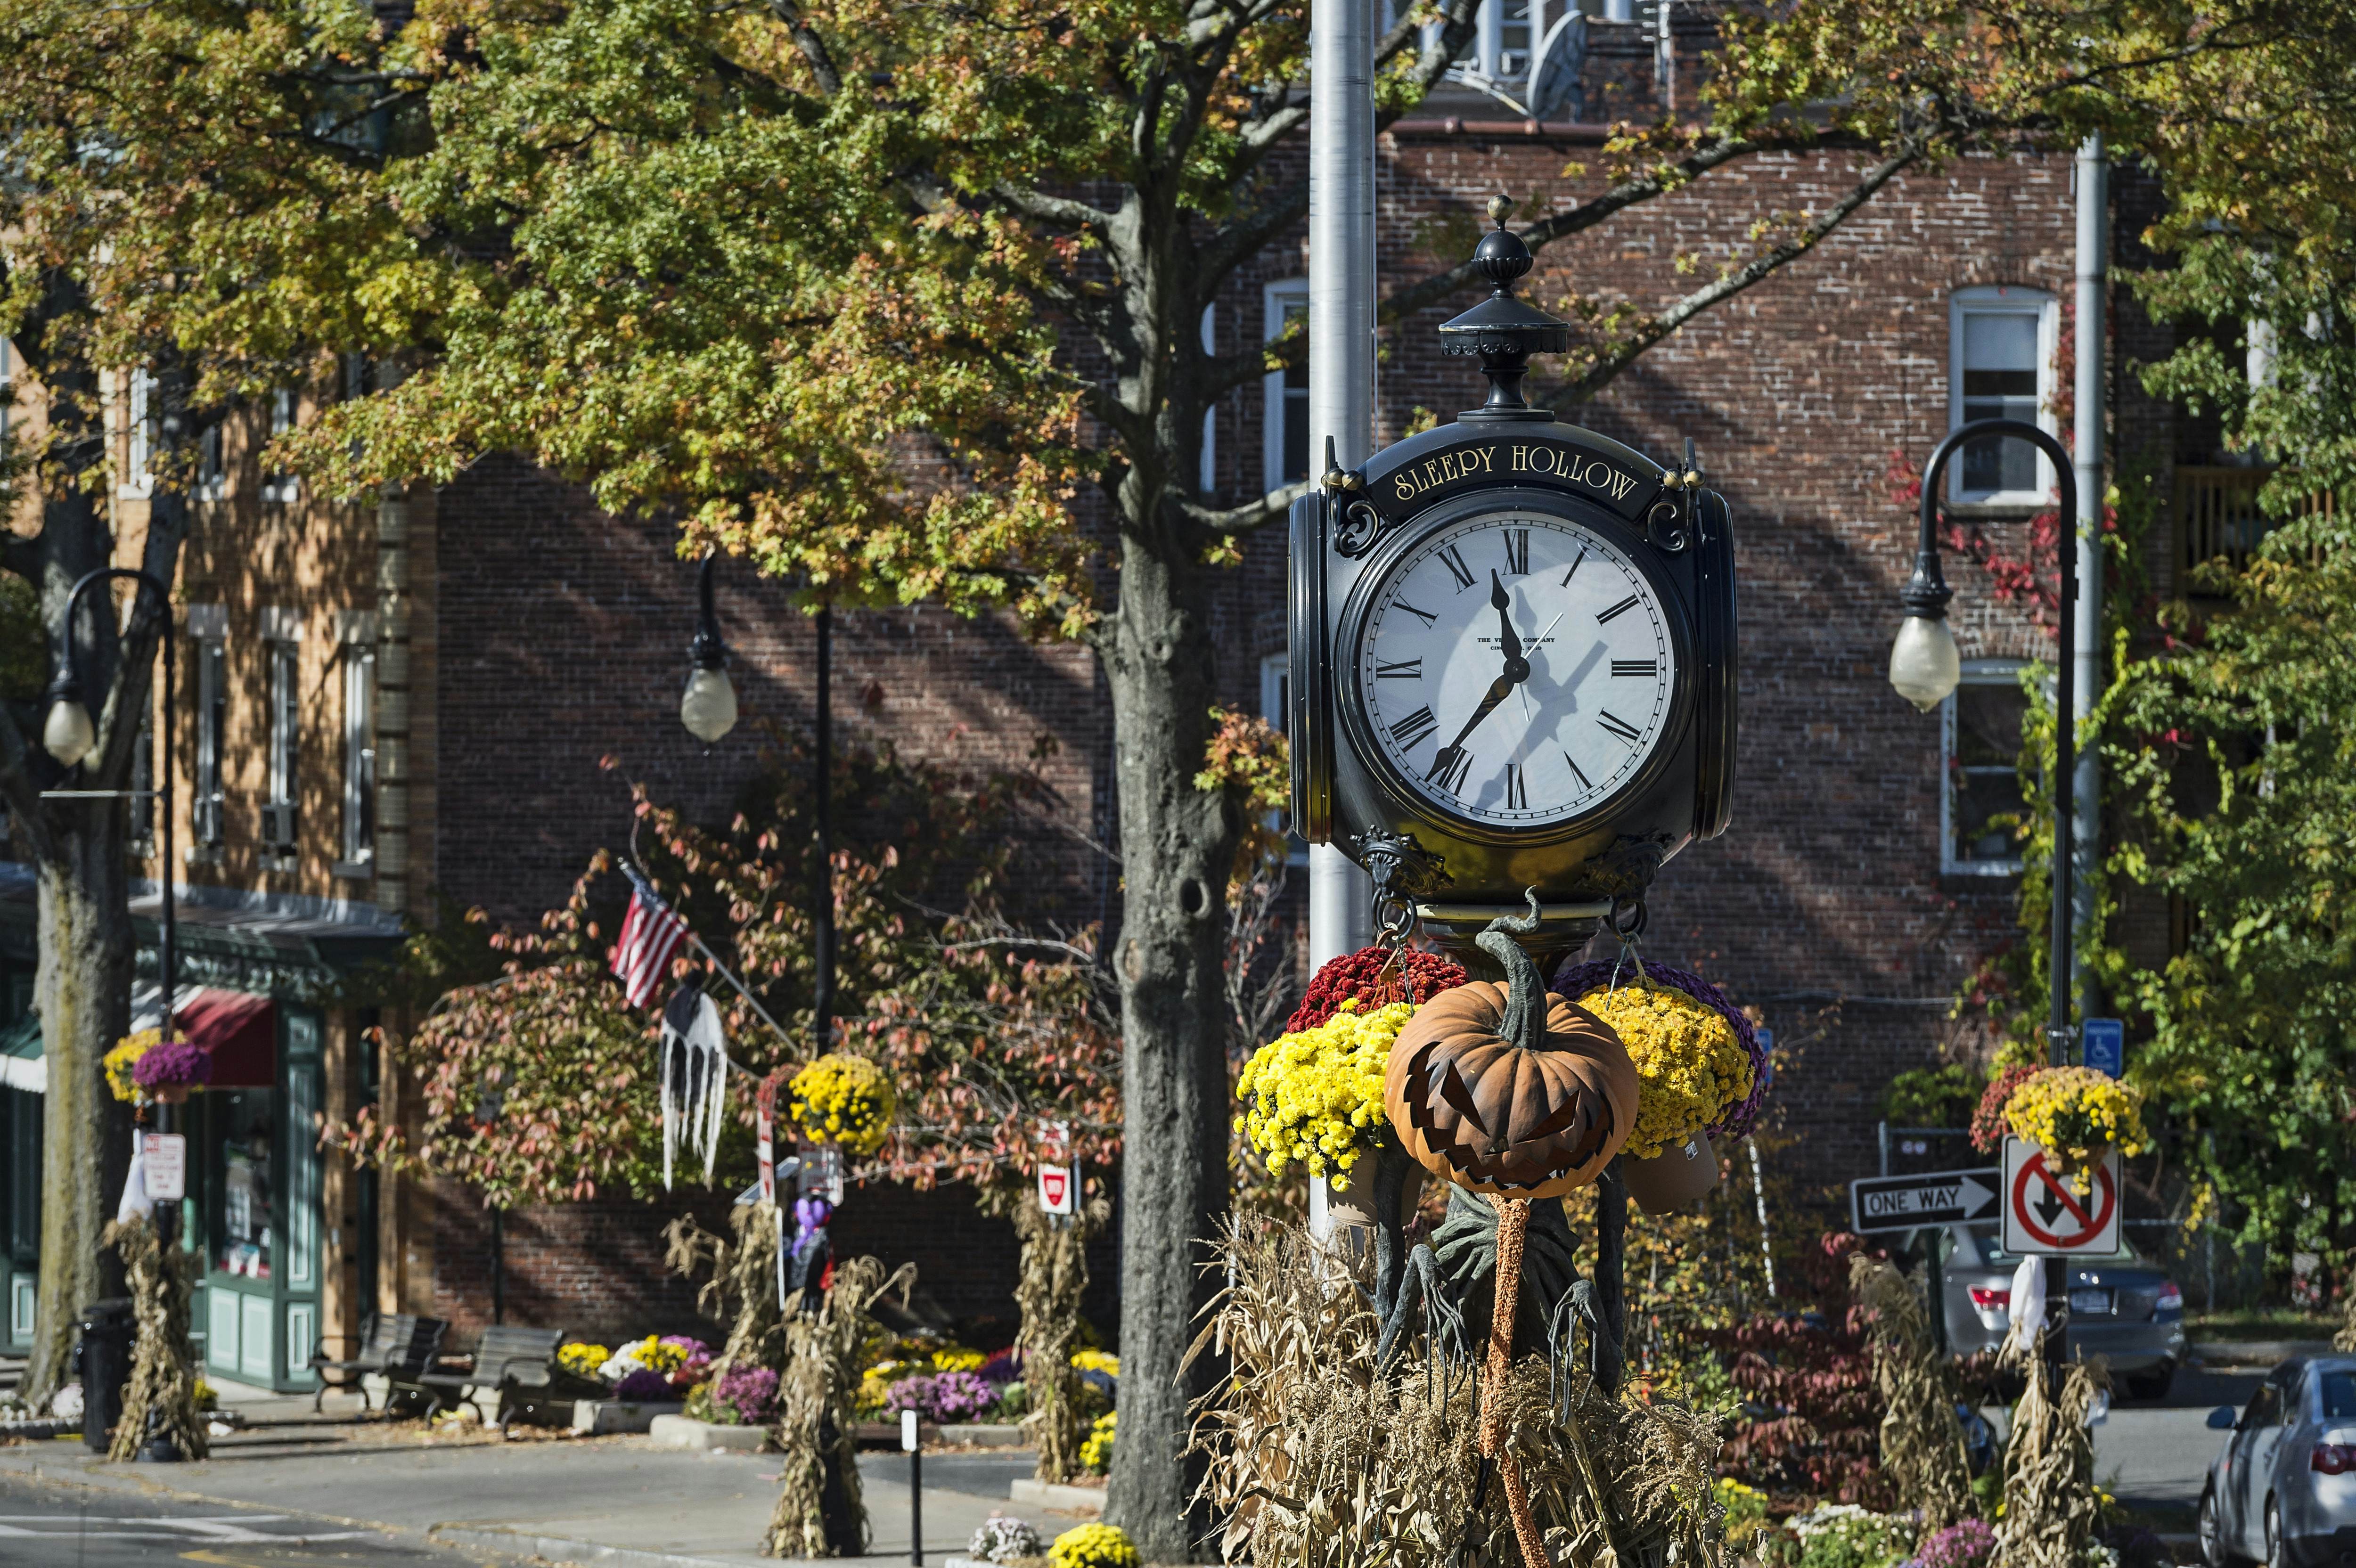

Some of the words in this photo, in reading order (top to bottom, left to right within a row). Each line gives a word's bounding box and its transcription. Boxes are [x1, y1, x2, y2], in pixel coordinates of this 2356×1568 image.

[1395, 446, 1496, 500] SLEEPY
[1511, 446, 1638, 500] HOLLOW
[1434, 543, 1478, 595] XI
[1501, 529, 1530, 575] XII
[1559, 545, 1590, 588] I
[1390, 591, 1439, 629] X
[1595, 592, 1641, 627] II
[1376, 655, 1422, 681] IX
[1611, 658, 1657, 679] III
[1388, 703, 1440, 755] VIII
[1595, 707, 1643, 750] IV
[1505, 763, 1530, 809] VI
[1564, 751, 1595, 794] V
[1870, 1191, 1910, 1213] ONE
[1919, 1186, 1959, 1209] WAY
